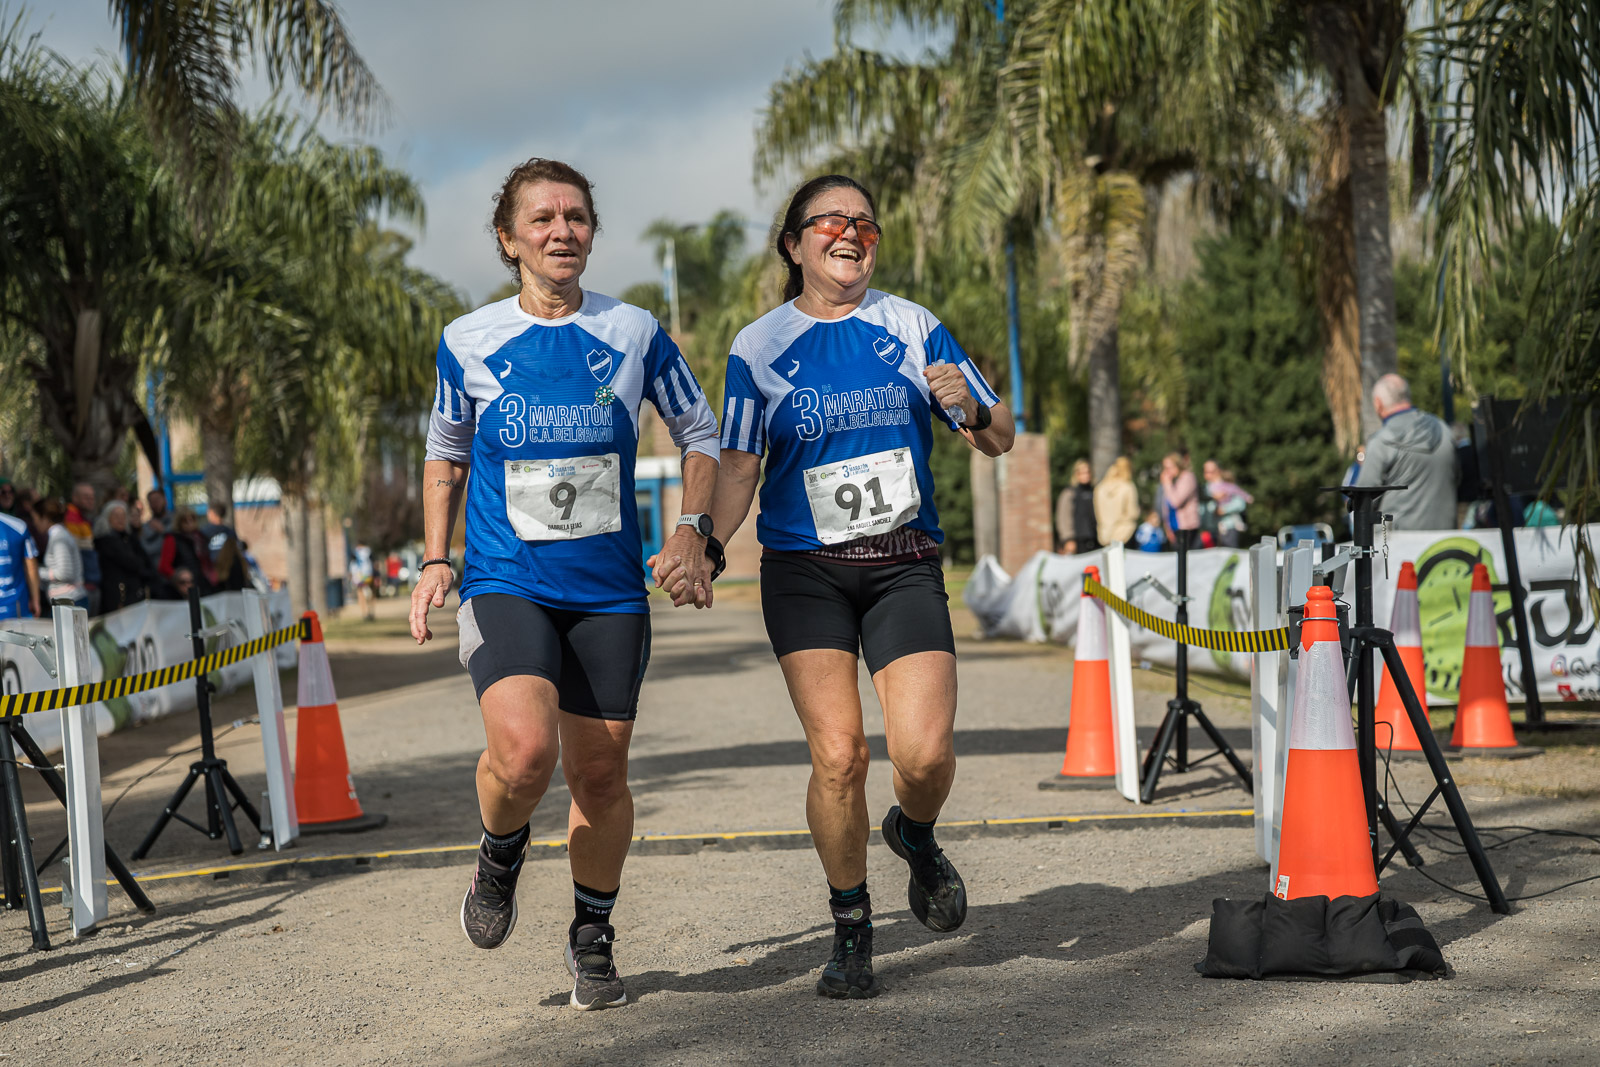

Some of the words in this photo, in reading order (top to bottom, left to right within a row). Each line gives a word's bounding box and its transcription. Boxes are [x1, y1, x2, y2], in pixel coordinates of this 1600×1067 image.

[793, 387, 823, 441] 3
[823, 382, 909, 417] MARATÓN
[499, 393, 526, 448] 3
[529, 427, 614, 442] C.A.BELGRANO
[826, 409, 910, 433] C.A.BELGRANO
[548, 464, 555, 478] 3
[842, 465, 850, 478] 3
[549, 481, 577, 520] 9
[834, 476, 894, 521] 91
[872, 517, 892, 526] SANCHEZ
